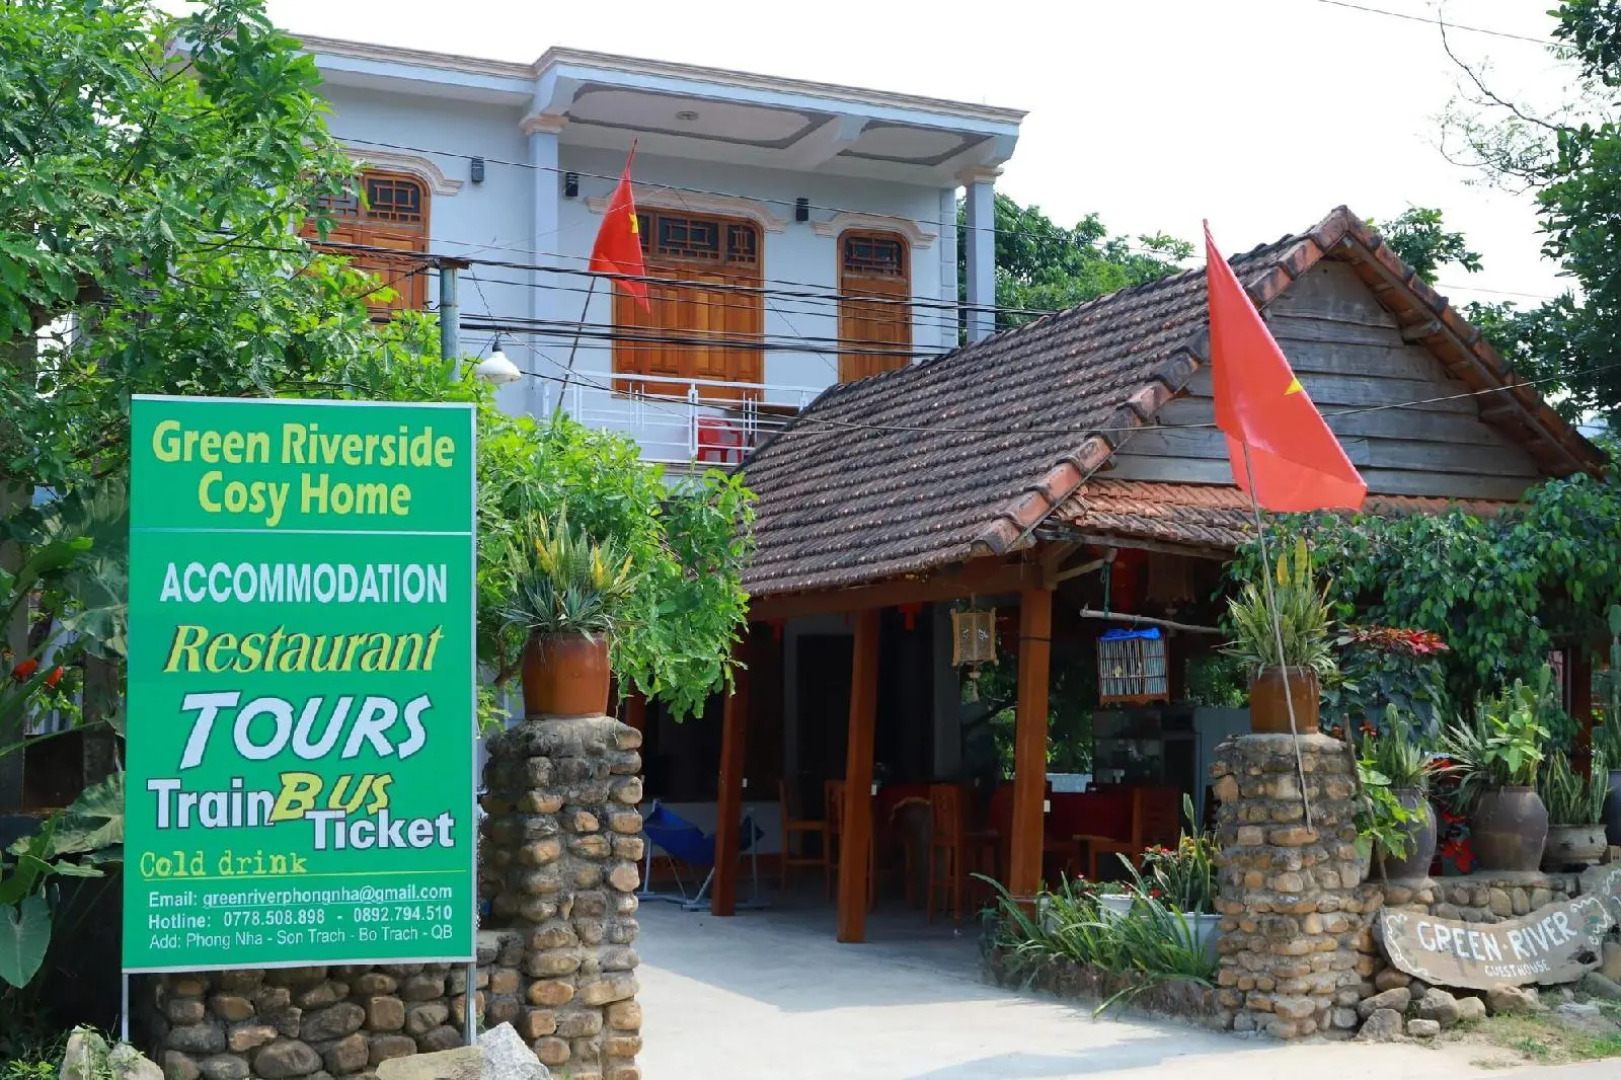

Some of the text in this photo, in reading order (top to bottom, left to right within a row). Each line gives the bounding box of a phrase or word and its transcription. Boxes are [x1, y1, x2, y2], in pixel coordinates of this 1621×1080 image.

[152, 419, 455, 467] Green Riverside
[198, 470, 412, 527] Cosy Home
[159, 561, 447, 604] ACCOMMODATION
[163, 623, 444, 673] Restaurant
[178, 690, 433, 770] TOURS
[146, 771, 395, 829] Train BUS
[303, 808, 456, 851] Ticket
[139, 849, 308, 878] Cold drink
[147, 913, 212, 930] Hotline:
[223, 908, 326, 927] 0778.508.898
[353, 904, 453, 923] 0892.794.510
[149, 884, 453, 910] Email: greenriverphongnha@gmail.com
[149, 934, 181, 950] Add:
[186, 933, 231, 950] Phong
[235, 931, 263, 946] Nha
[277, 930, 304, 945] Son
[308, 927, 346, 943] Trach
[358, 927, 378, 942] Bo
[381, 924, 419, 941] Trach
[431, 924, 453, 940] QB
[1417, 911, 1578, 962] GREEN RIVER
[1484, 958, 1551, 978] GUESTHOUSE
